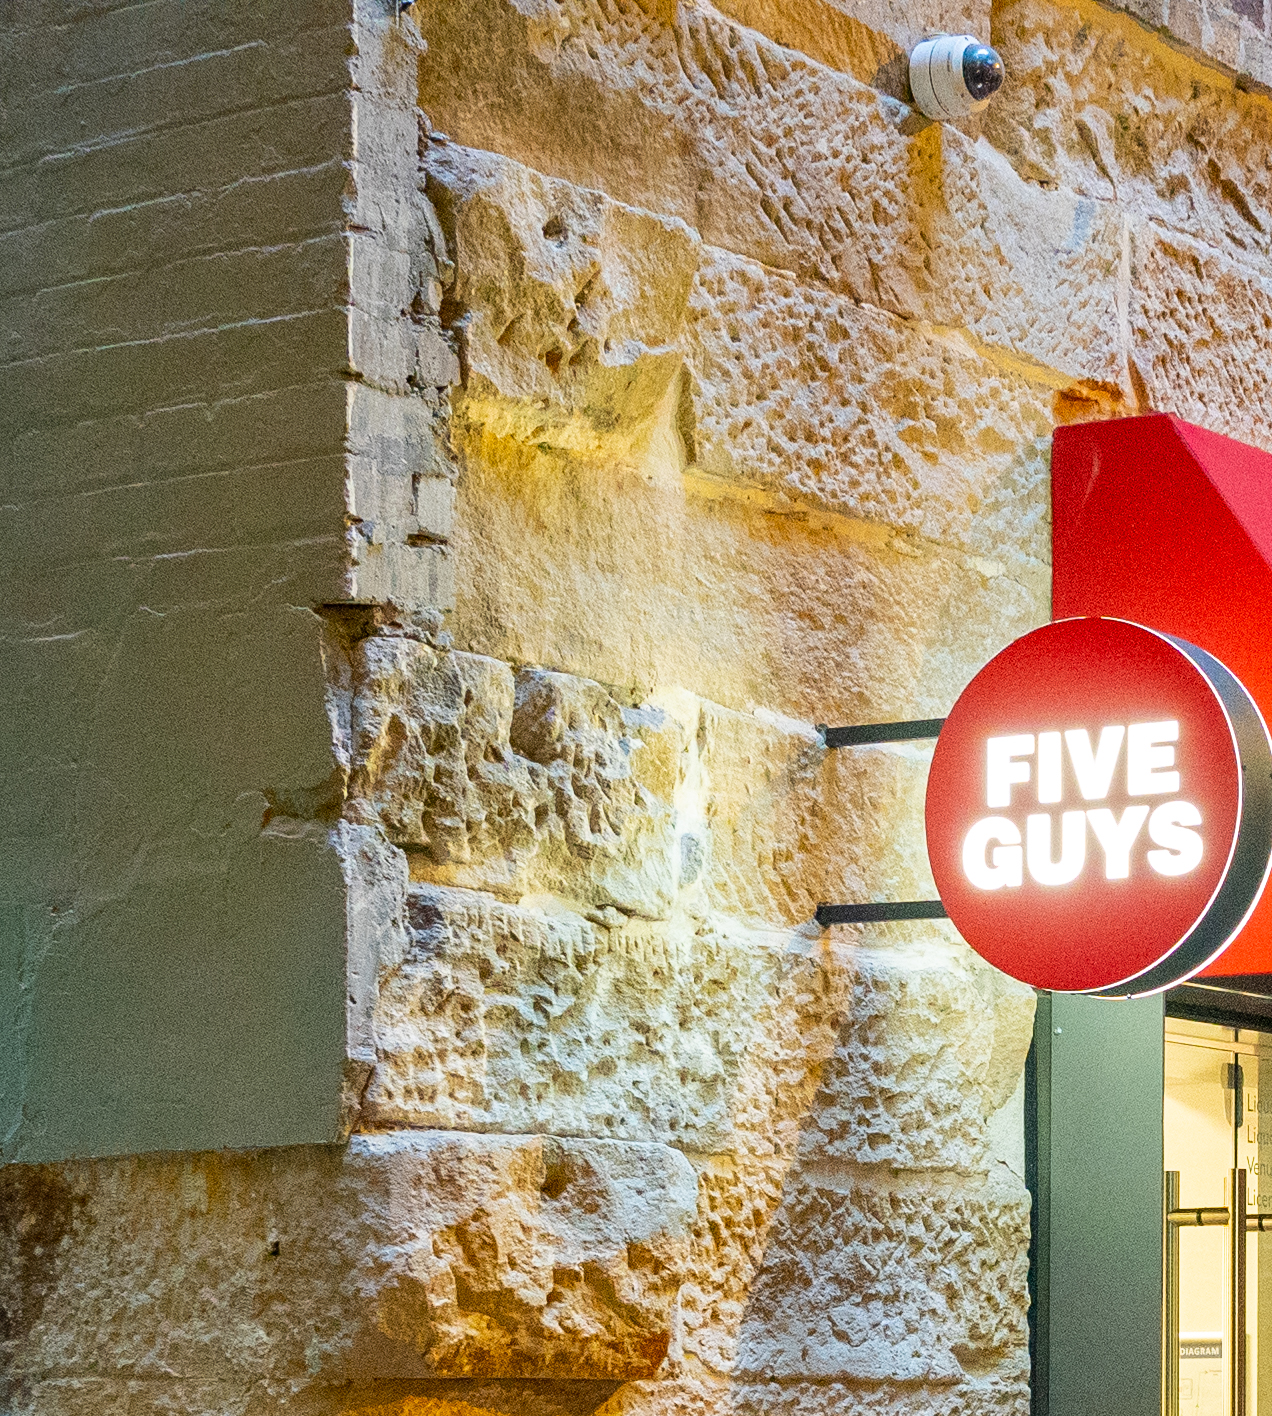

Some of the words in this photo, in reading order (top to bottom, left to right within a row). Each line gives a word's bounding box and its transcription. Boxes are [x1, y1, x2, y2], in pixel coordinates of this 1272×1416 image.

[986, 720, 1180, 808] FIVE
[962, 800, 1204, 891] GUYS
[1180, 1347, 1220, 1356] DIAGRAM
